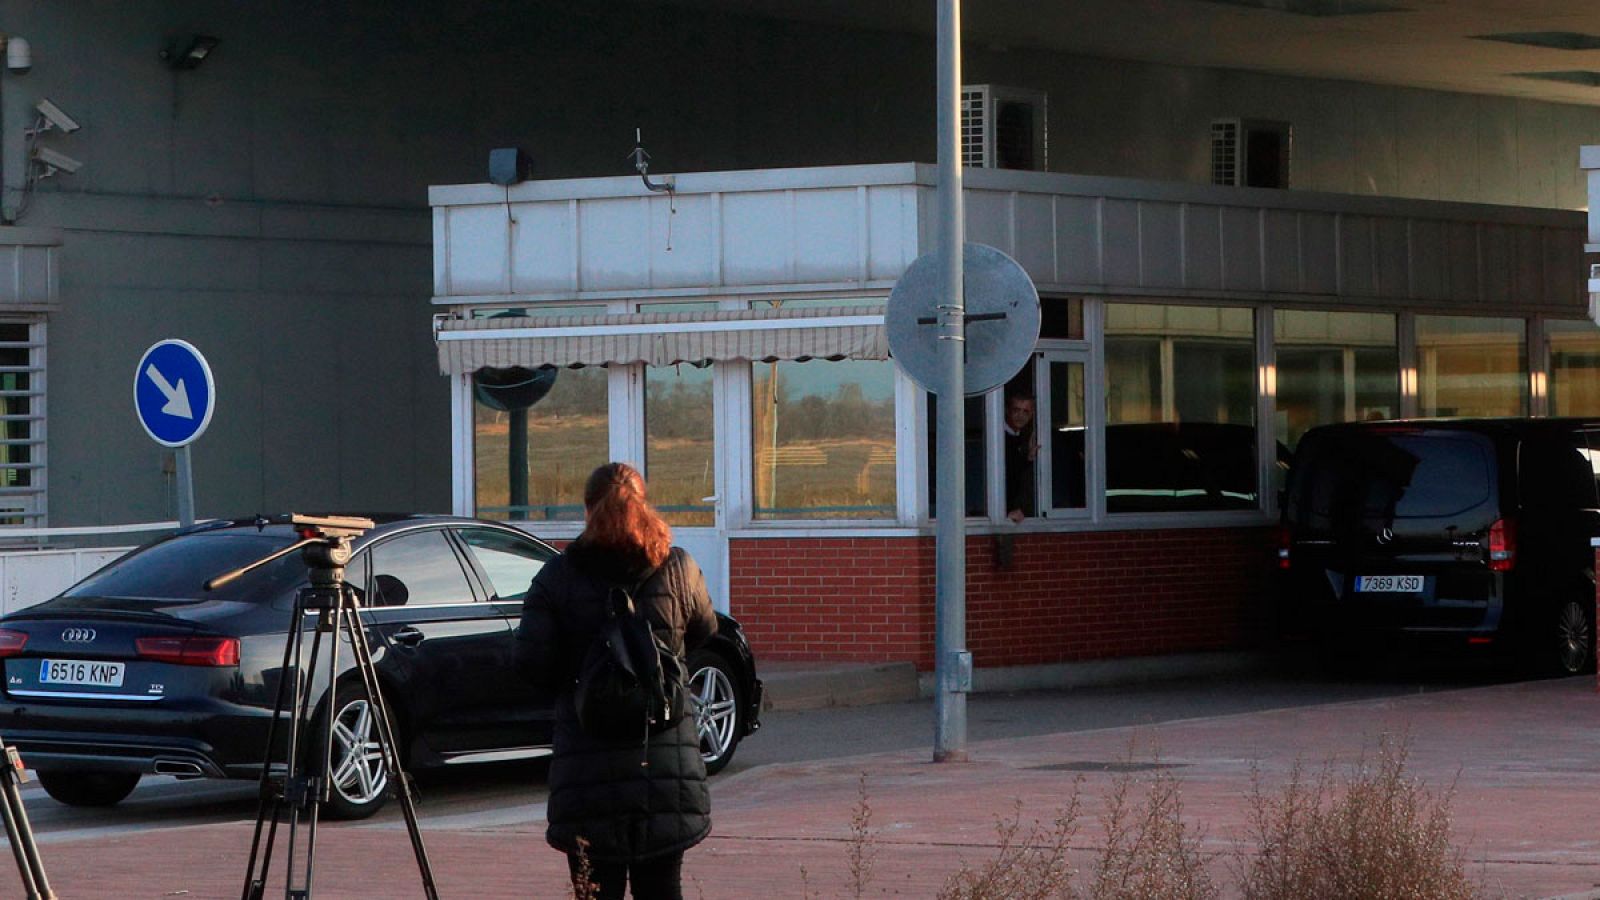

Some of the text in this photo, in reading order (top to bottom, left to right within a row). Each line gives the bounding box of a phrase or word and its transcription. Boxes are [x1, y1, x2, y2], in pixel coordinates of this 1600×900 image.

[1364, 577, 1420, 590] 7369 KSD
[51, 663, 118, 683] 6516 KNP
